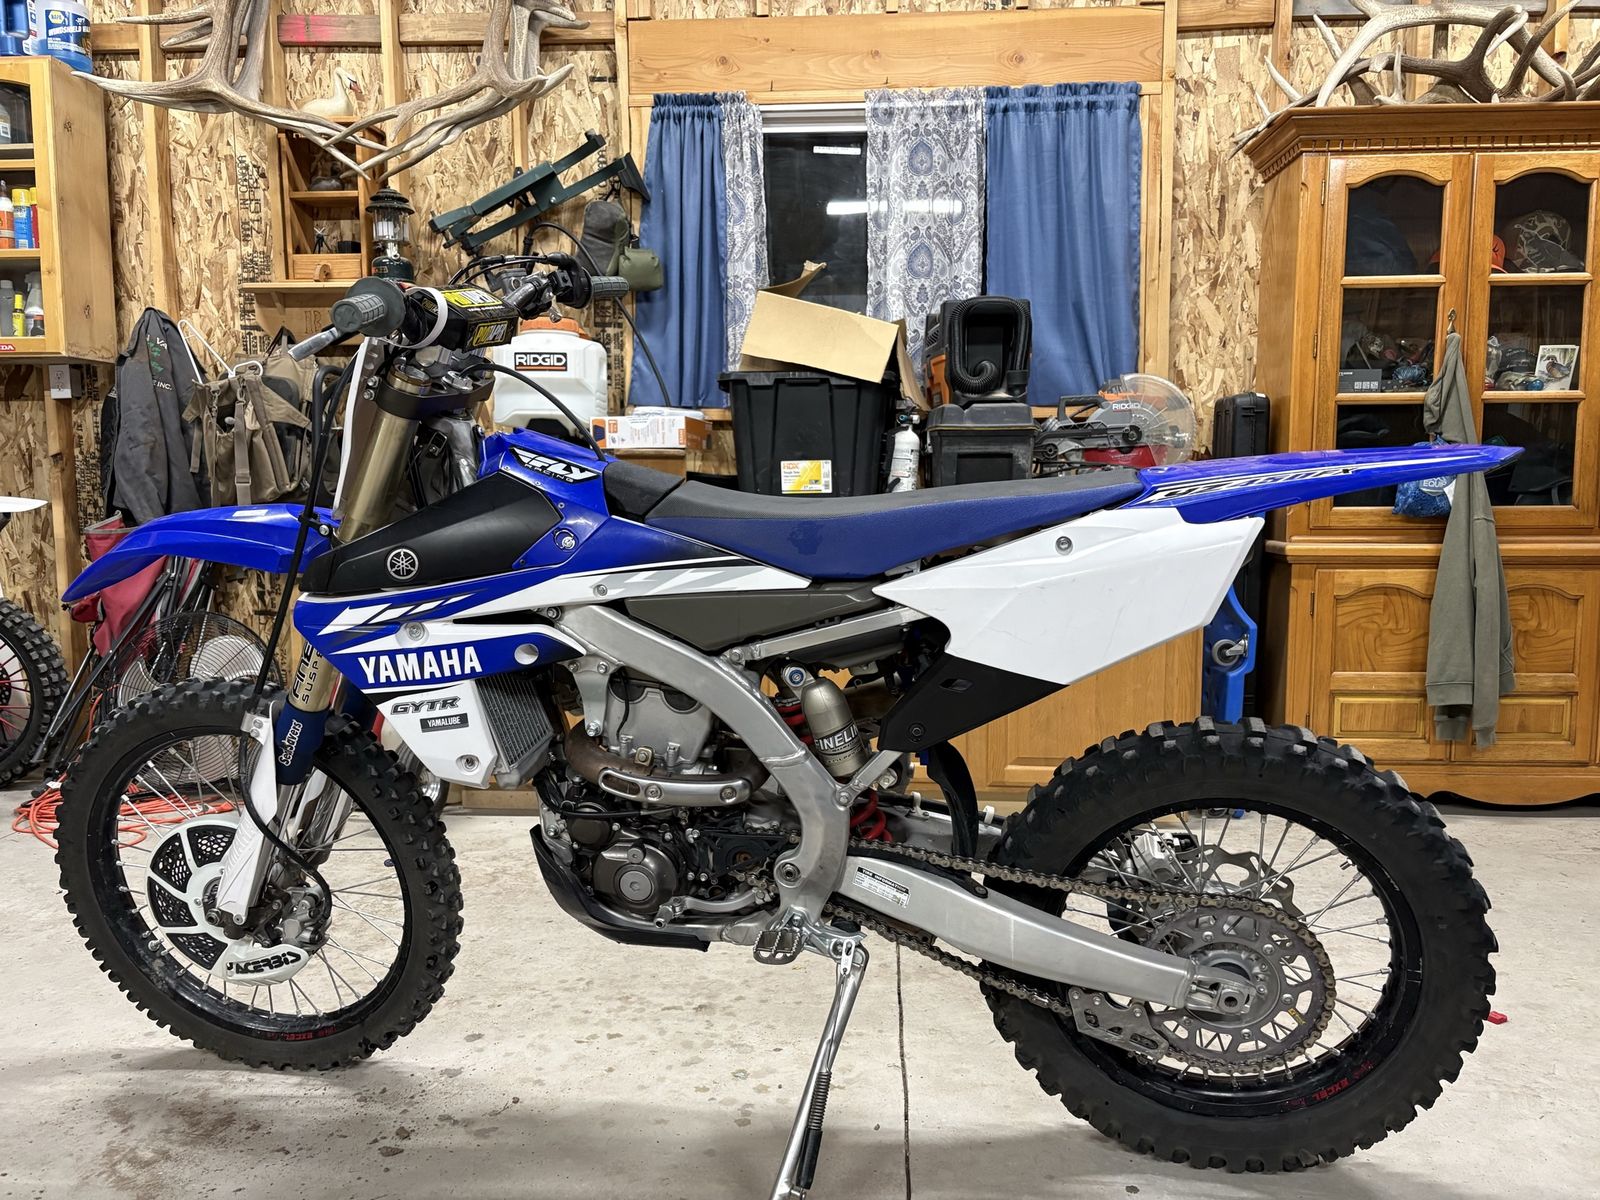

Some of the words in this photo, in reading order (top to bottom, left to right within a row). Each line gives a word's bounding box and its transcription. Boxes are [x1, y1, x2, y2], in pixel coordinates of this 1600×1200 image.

[515, 354, 566, 366] RIDGID
[156, 381, 173, 391] INC.
[1112, 402, 1141, 411] RIDGID
[515, 449, 598, 480] FLY
[524, 463, 575, 483] RACING
[292, 641, 316, 699] FINE
[358, 646, 483, 684] YAMAHA
[390, 695, 461, 715] GYTR
[427, 716, 461, 728] YAMALUBE
[1313, 1078, 1350, 1101] EXCEL
